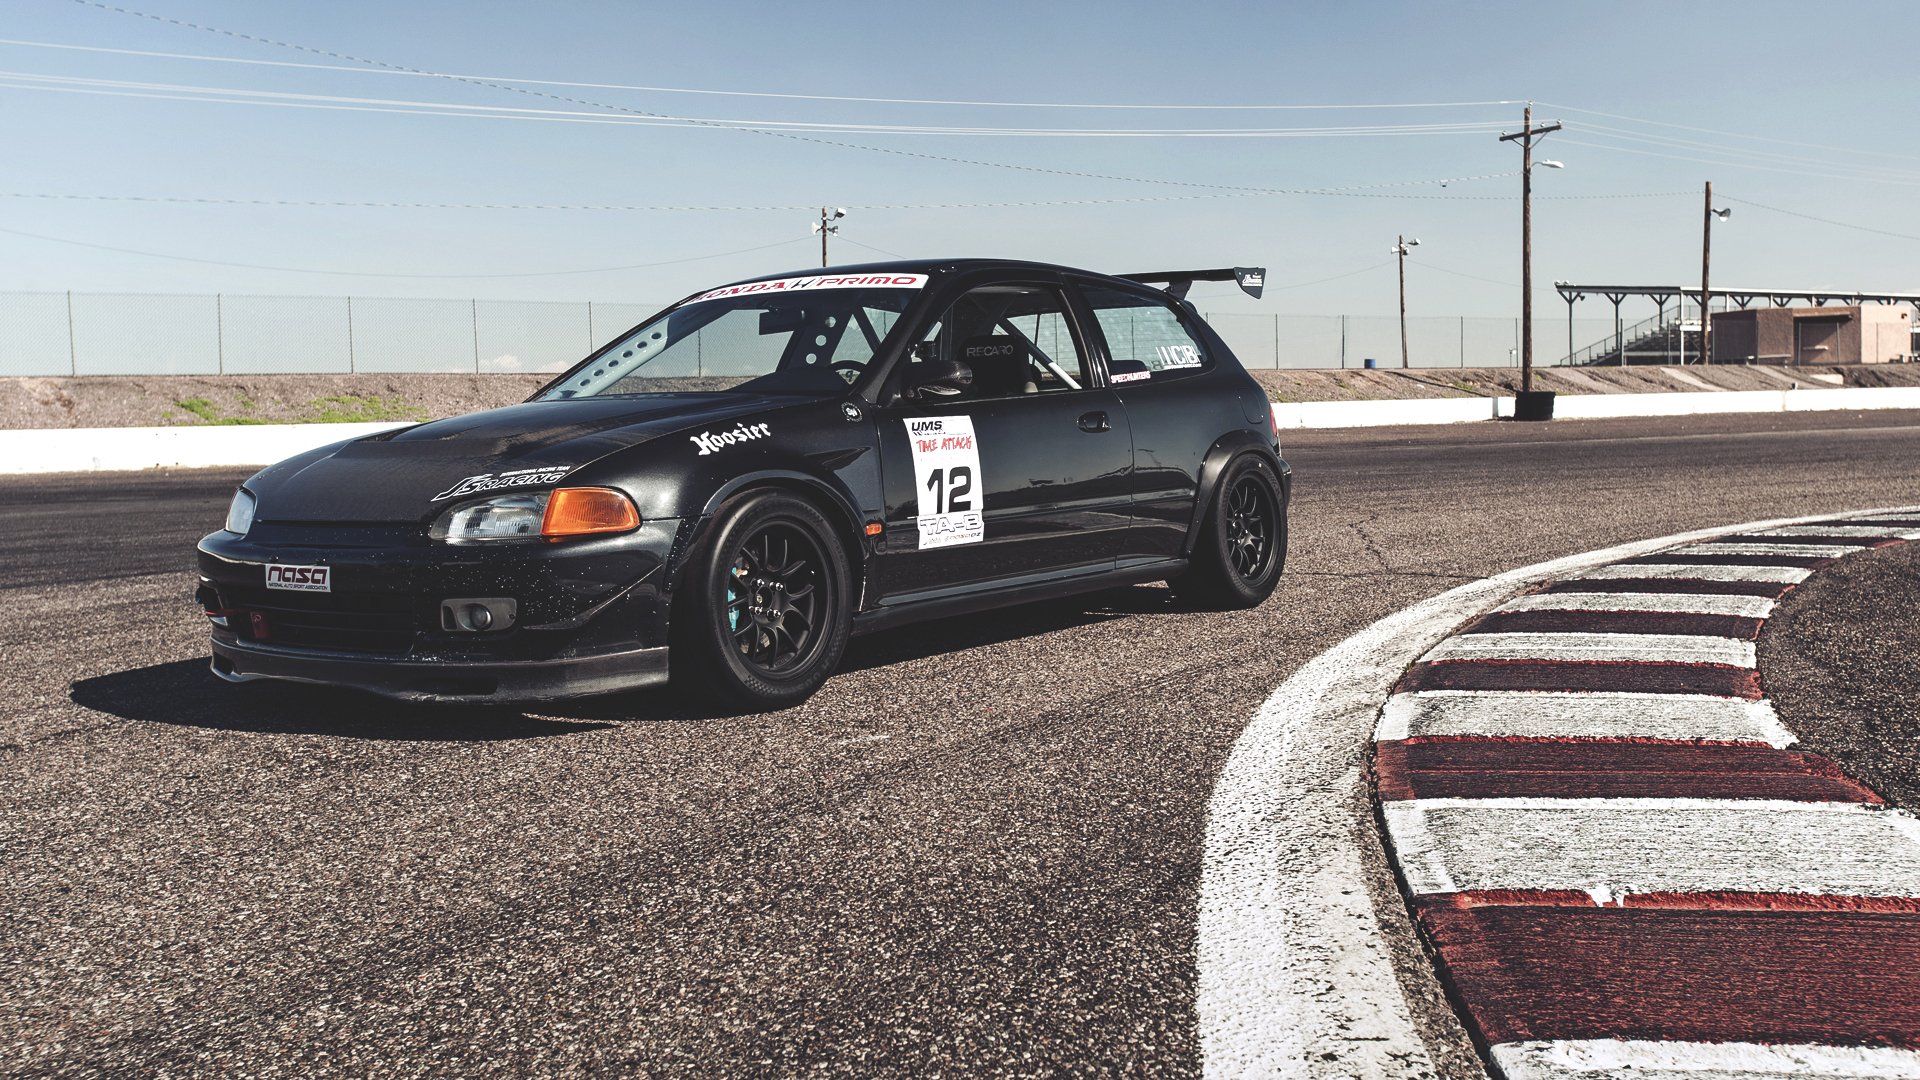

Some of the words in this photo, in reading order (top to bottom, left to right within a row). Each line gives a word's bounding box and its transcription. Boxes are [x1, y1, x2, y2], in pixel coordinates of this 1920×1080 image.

[816, 276, 917, 287] PRIMO
[966, 344, 1014, 358] RECARO
[911, 421, 943, 432] UMS
[690, 422, 771, 456] Hoosier
[916, 438, 938, 453] TIME
[941, 435, 972, 451] ATTACK
[926, 466, 972, 514] 12
[919, 513, 983, 536] TA-B
